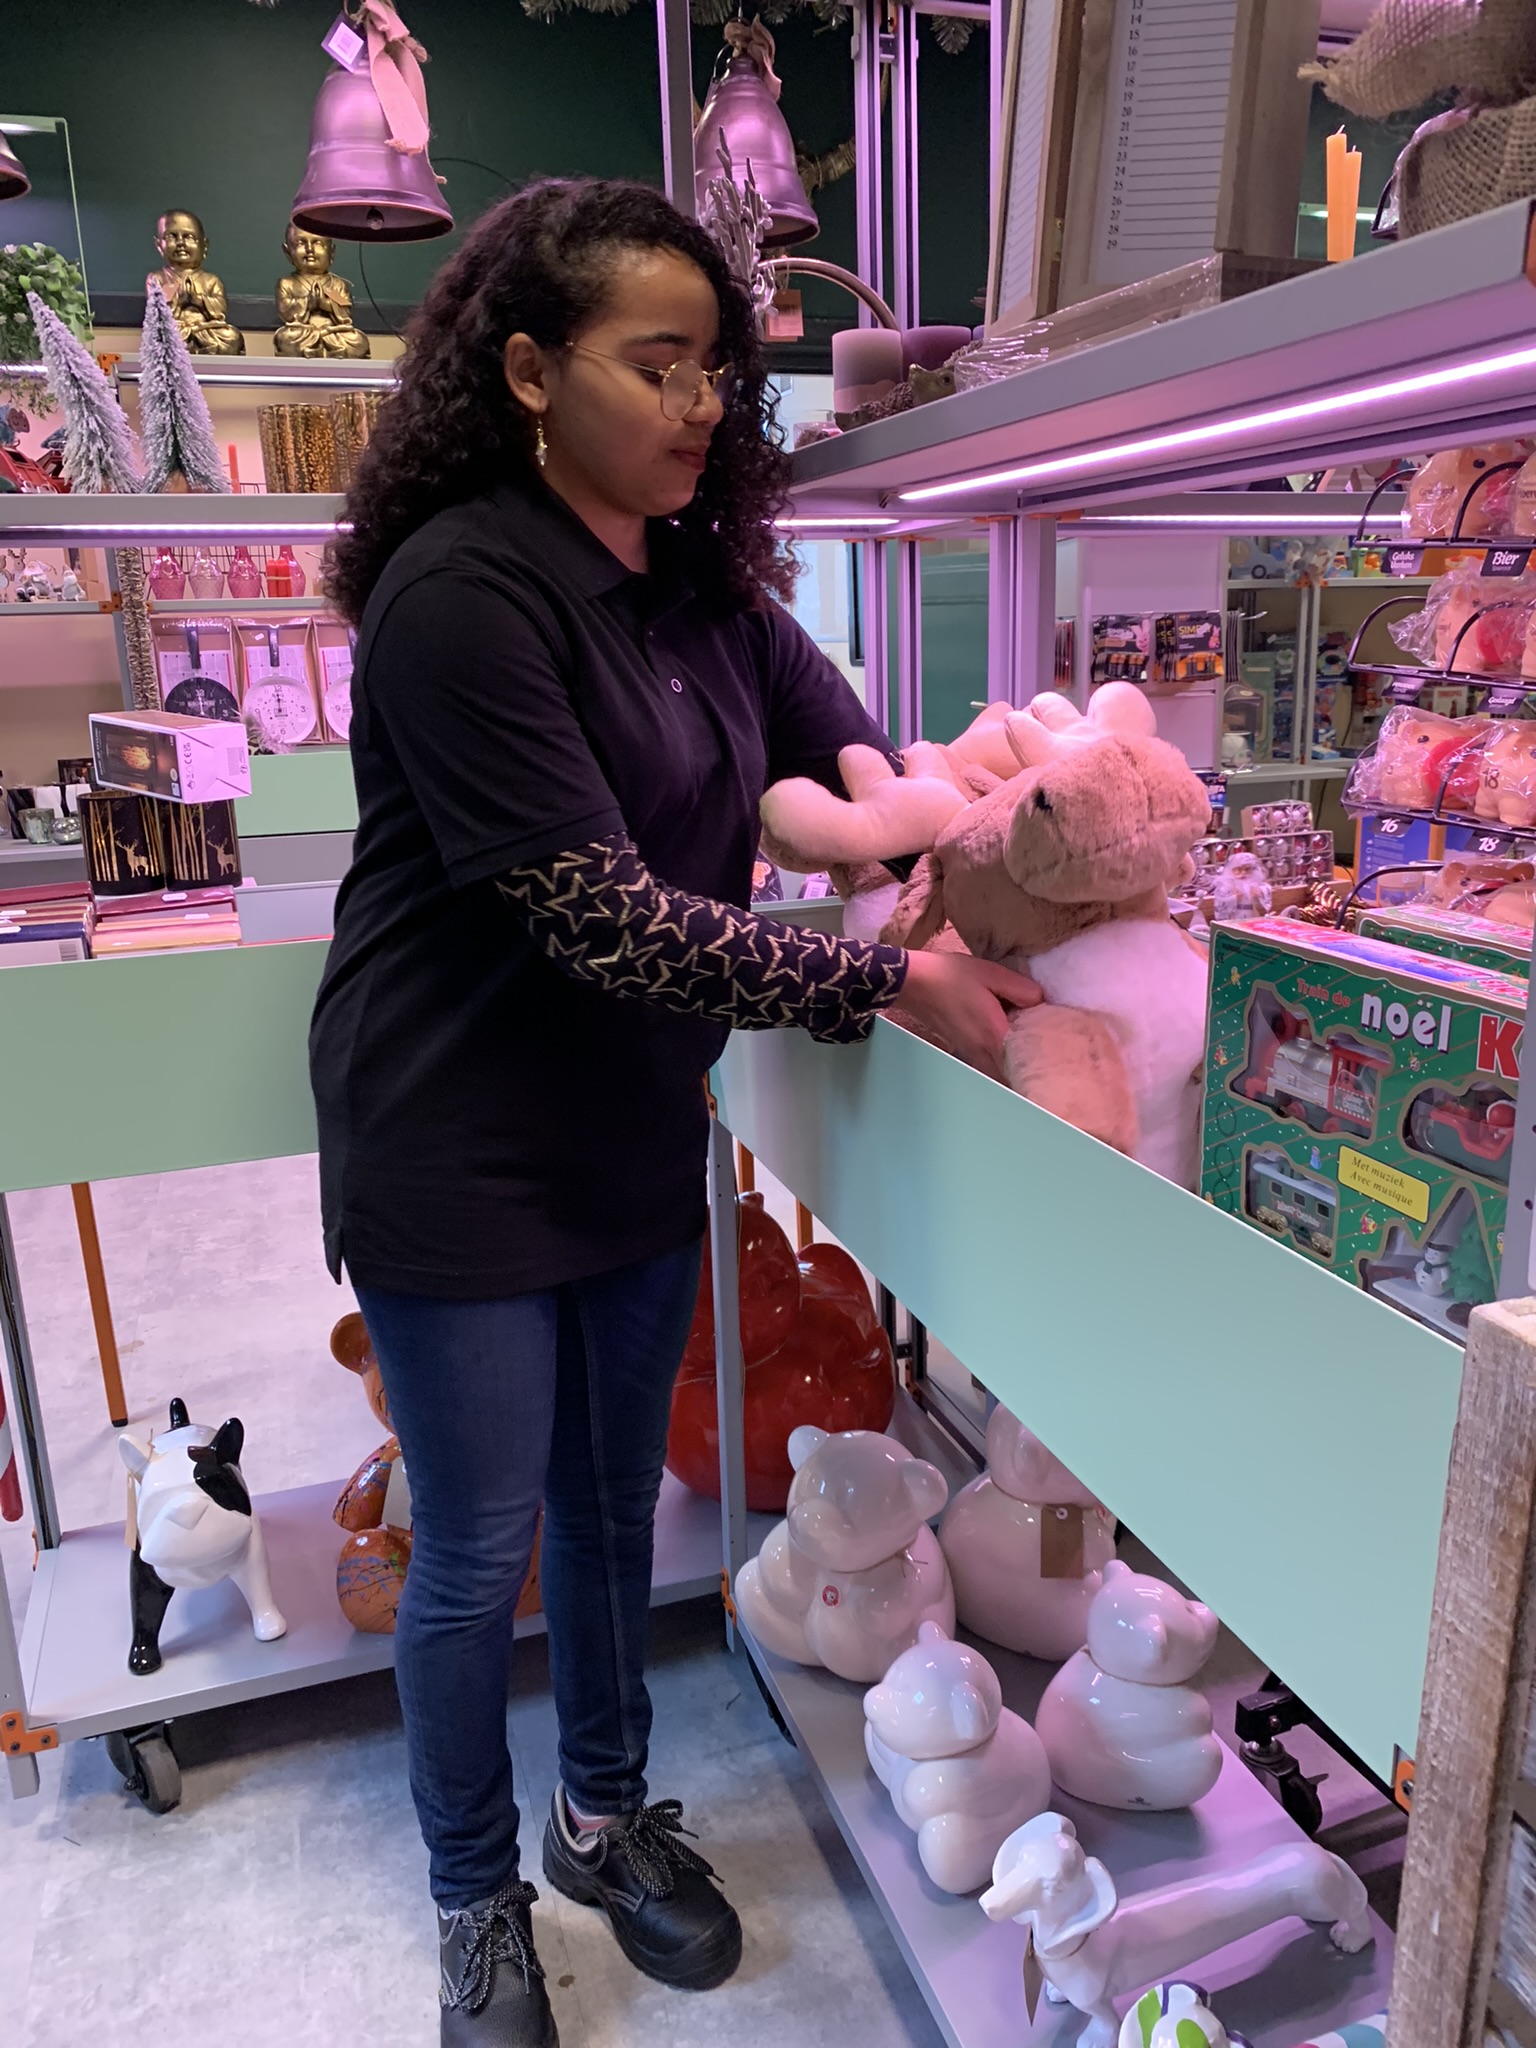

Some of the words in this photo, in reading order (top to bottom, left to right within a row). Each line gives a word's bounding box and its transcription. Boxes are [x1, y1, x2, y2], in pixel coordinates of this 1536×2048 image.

[1131, 14, 1142, 25] 14
[1129, 29, 1140, 40] 15
[1128, 46, 1138, 56] 16
[1127, 61, 1136, 71] 17
[1125, 76, 1135, 87] 18
[1123, 91, 1134, 101] 19
[1121, 106, 1132, 117] 20
[1120, 121, 1130, 132] 21
[1118, 136, 1129, 146] 22
[1116, 151, 1127, 162] 23
[1115, 166, 1126, 176] 24
[1113, 180, 1124, 191] 25
[1111, 196, 1122, 206] 26
[1110, 210, 1120, 220] 27
[1108, 224, 1119, 235] 28
[1106, 239, 1118, 250] 29
[1492, 551, 1520, 566] Bier
[1179, 624, 1211, 635] SIMP
[195, 688, 205, 696] 12
[222, 709, 228, 717] 3
[300, 705, 306, 713] 3
[1483, 766, 1500, 789] 18
[1381, 818, 1400, 833] 16
[1478, 837, 1500, 852] 18
[1297, 977, 1329, 1002] Train
[1332, 990, 1351, 1008] de
[1361, 993, 1452, 1054] noël
[1351, 1156, 1370, 1172] Met
[1371, 1168, 1405, 1188] muziek
[1350, 1171, 1371, 1187] Avec
[1373, 1183, 1413, 1206] musique
